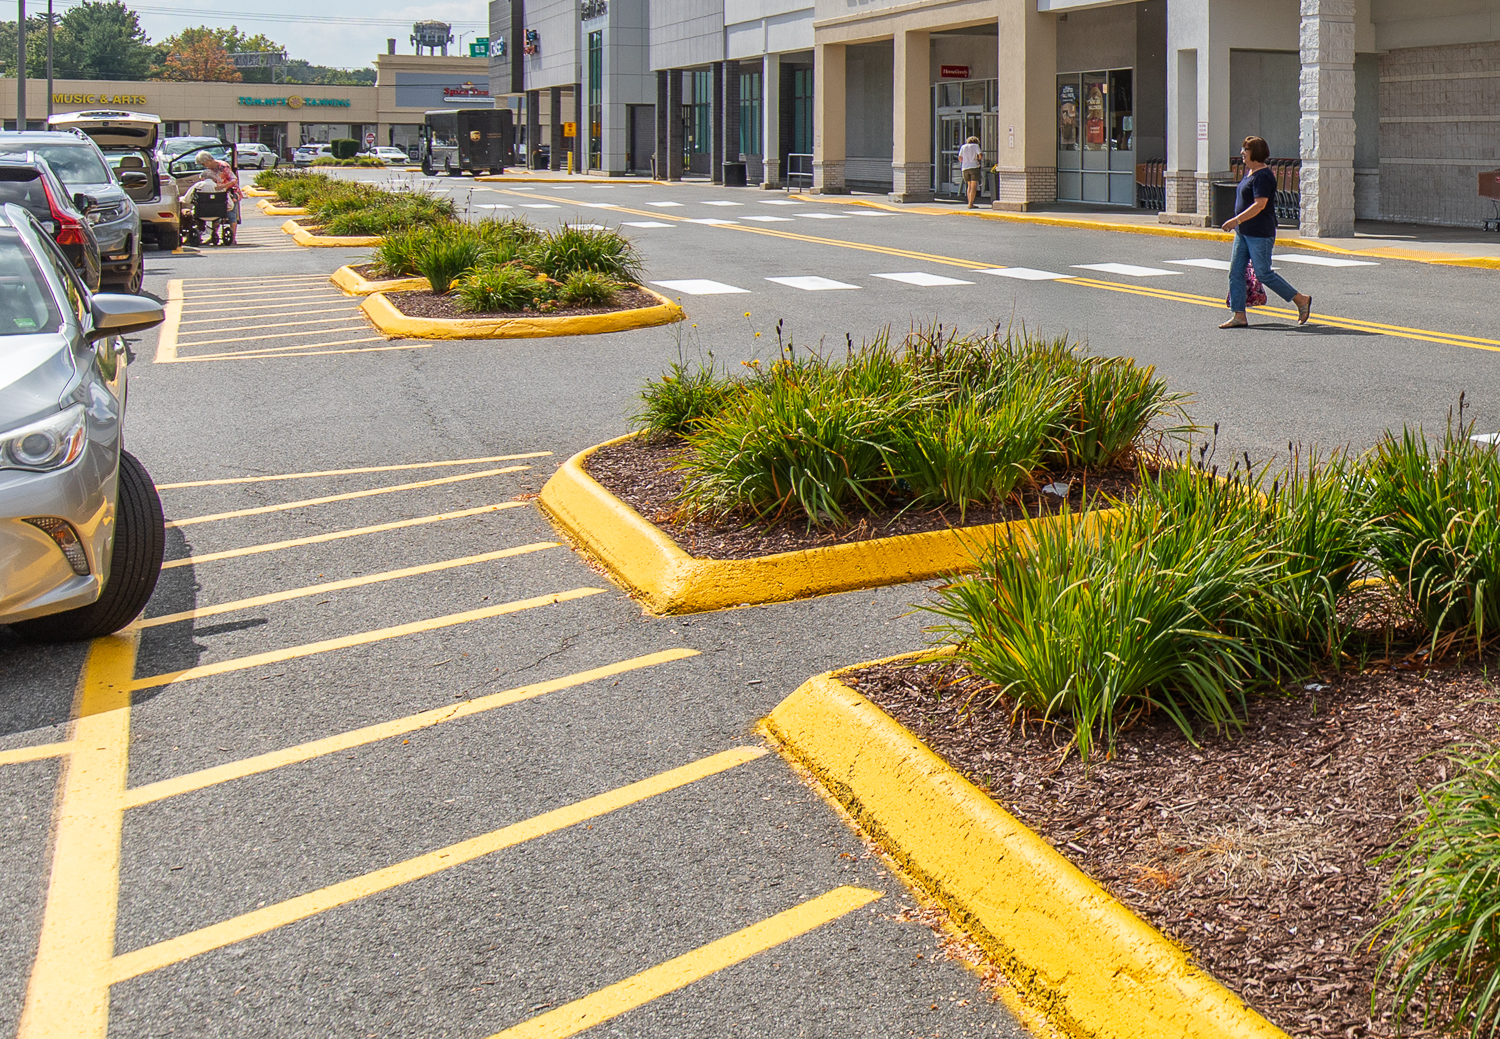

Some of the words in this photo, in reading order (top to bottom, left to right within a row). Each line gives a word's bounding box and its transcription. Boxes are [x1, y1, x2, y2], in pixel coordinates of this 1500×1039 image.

[52, 93, 95, 104] MUSIC
[100, 94, 108, 104] &
[112, 95, 147, 105] ARTS
[238, 96, 287, 106] TOMMY'S
[304, 98, 351, 107] TANNING
